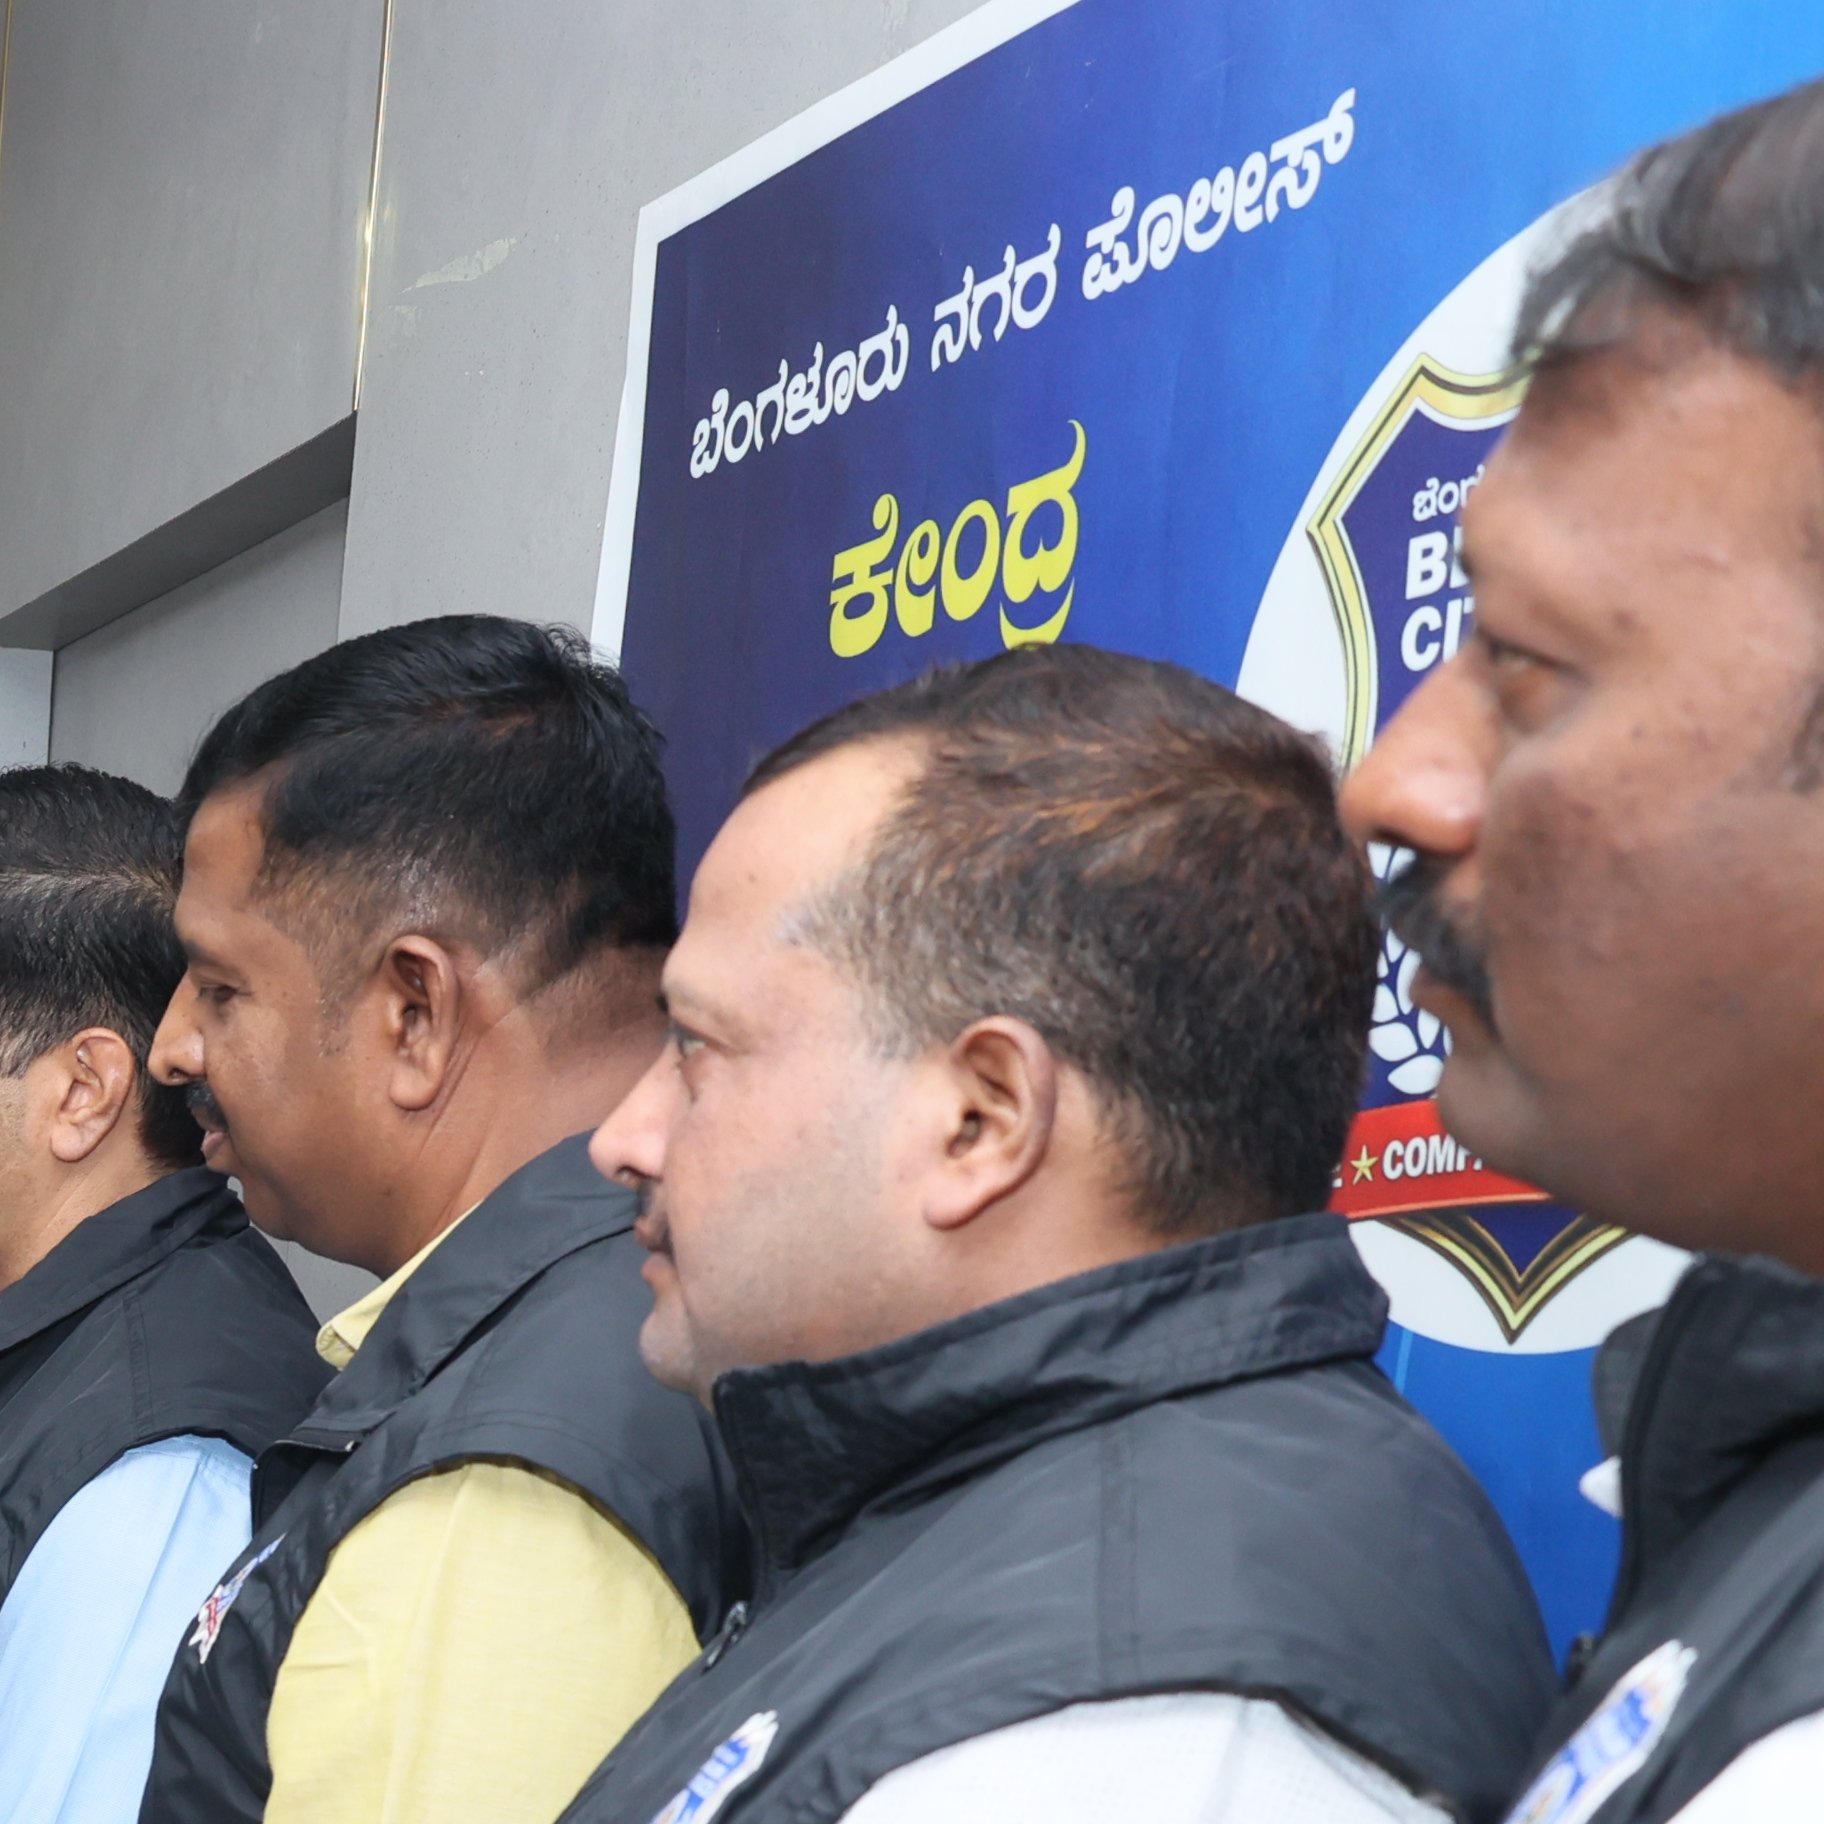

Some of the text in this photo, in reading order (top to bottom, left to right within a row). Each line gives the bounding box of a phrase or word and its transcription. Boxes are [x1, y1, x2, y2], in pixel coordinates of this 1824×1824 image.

[689, 87, 1356, 480] ಬೆಂಗಳೂರು ನಗರ ಪೊಲೀಸ್
[825, 419, 1087, 658] ಕೇಂದ್ರ
